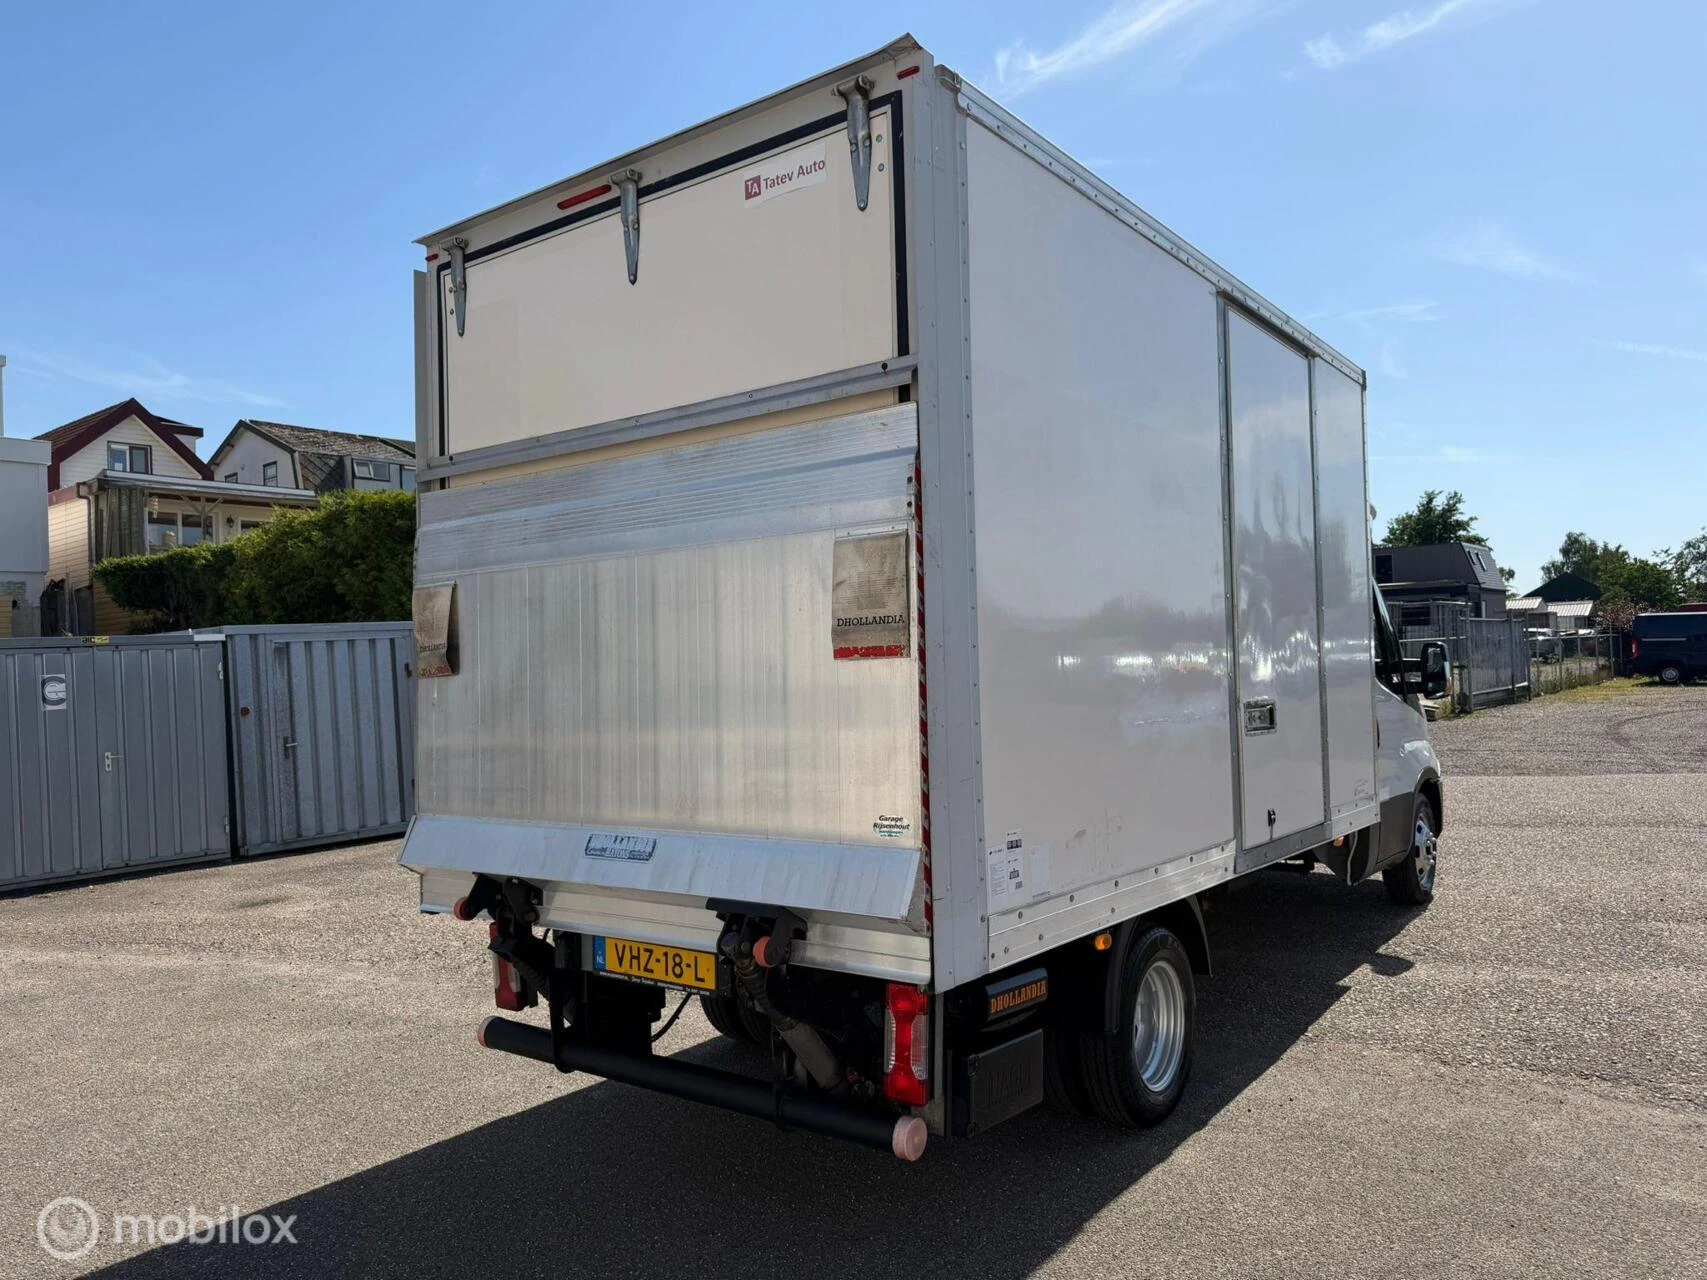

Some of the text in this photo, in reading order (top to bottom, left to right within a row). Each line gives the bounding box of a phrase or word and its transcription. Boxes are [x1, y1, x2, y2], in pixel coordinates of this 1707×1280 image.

[763, 160, 826, 190] Tatev Auto
[746, 180, 760, 196] TA
[836, 614, 905, 627] DHOLLANDIA
[878, 814, 904, 823] Garage
[614, 942, 706, 983] VHZ-18-L
[990, 980, 1047, 1014] DHOLLANDIA
